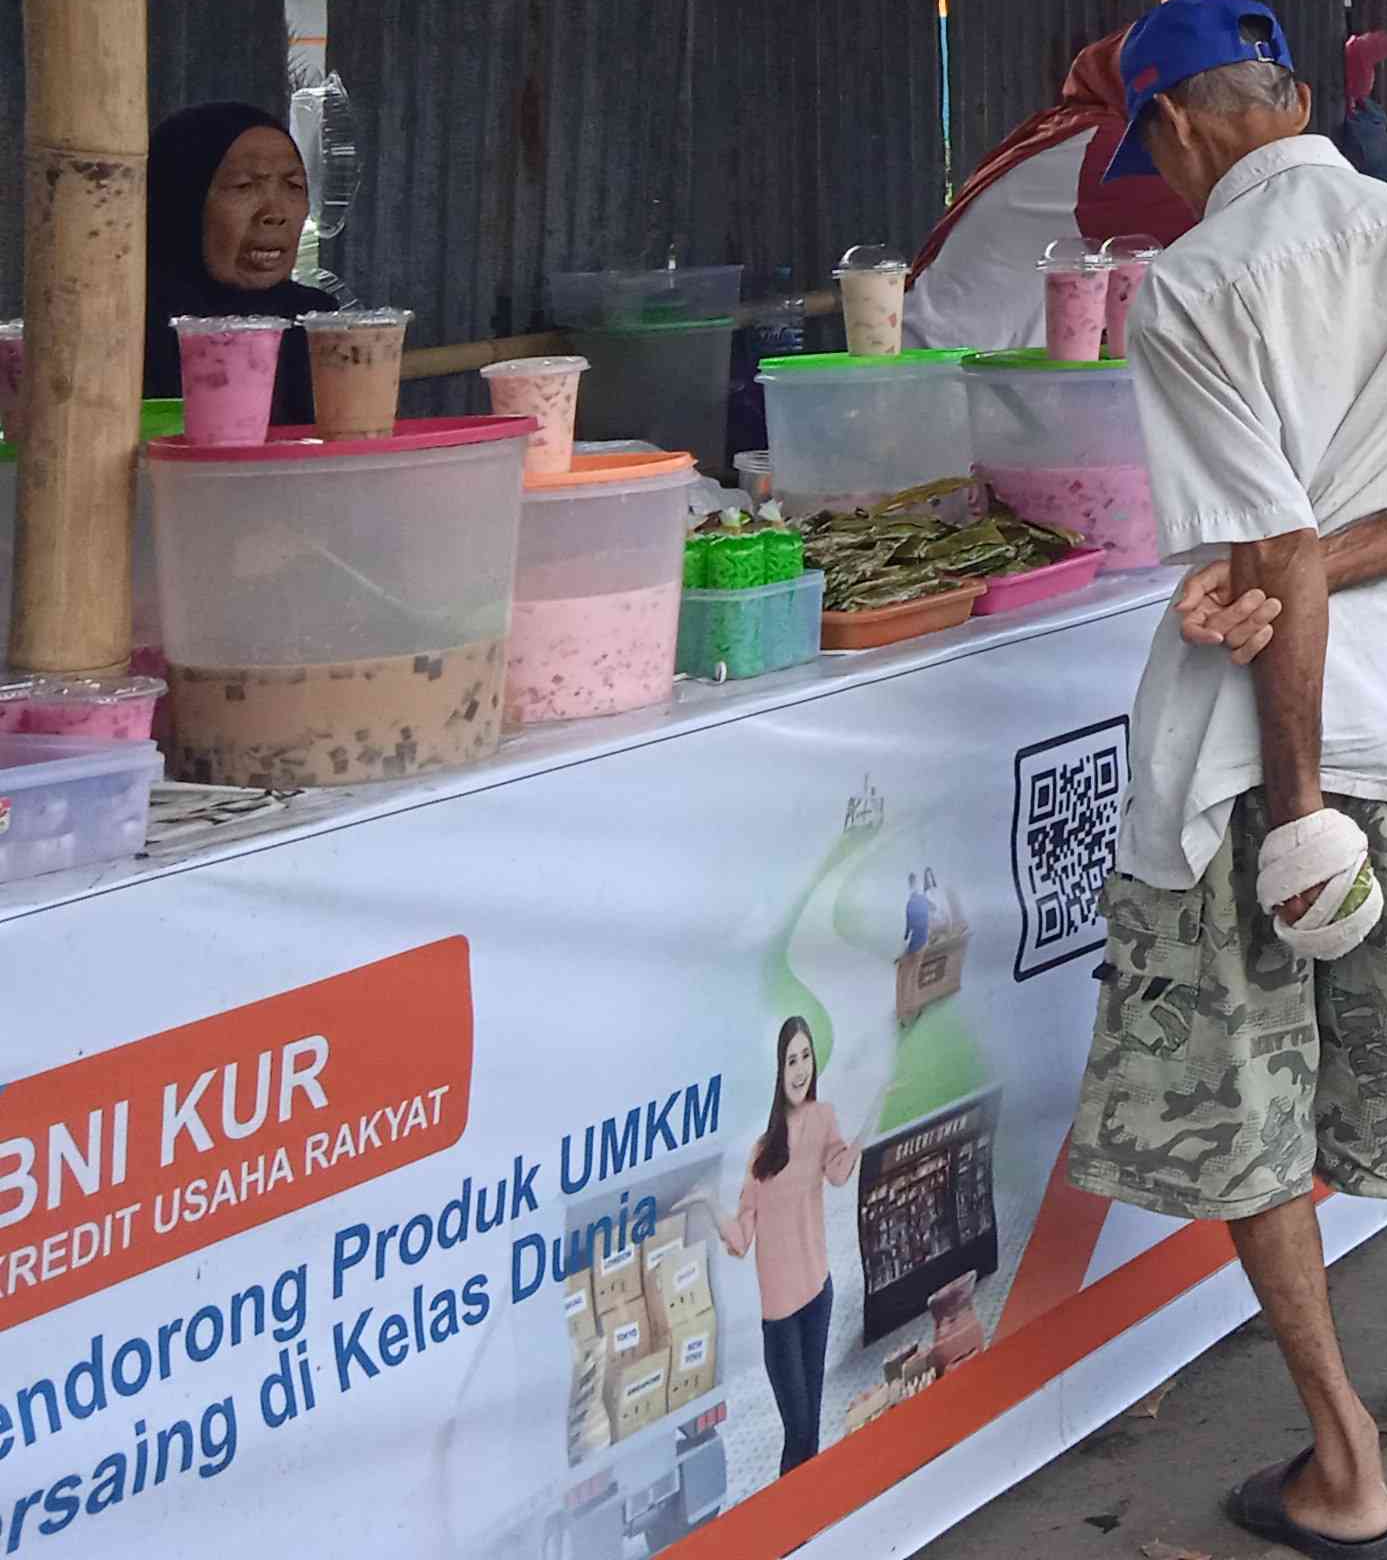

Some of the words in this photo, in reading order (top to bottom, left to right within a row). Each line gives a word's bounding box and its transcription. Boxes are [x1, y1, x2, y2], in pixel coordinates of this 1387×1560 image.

[0, 1100, 129, 1231] BNI
[159, 1033, 331, 1169] KUR
[0, 1201, 142, 1300] REDIT
[152, 1150, 293, 1235] USAHA
[303, 1083, 450, 1173] RAKYAT
[331, 1155, 541, 1298] Produk
[558, 1073, 724, 1197] UMKM
[0, 1399, 236, 1556] rsaing
[258, 1348, 317, 1432] di
[333, 1271, 492, 1395] Kelas
[509, 1189, 659, 1307] Dunia
